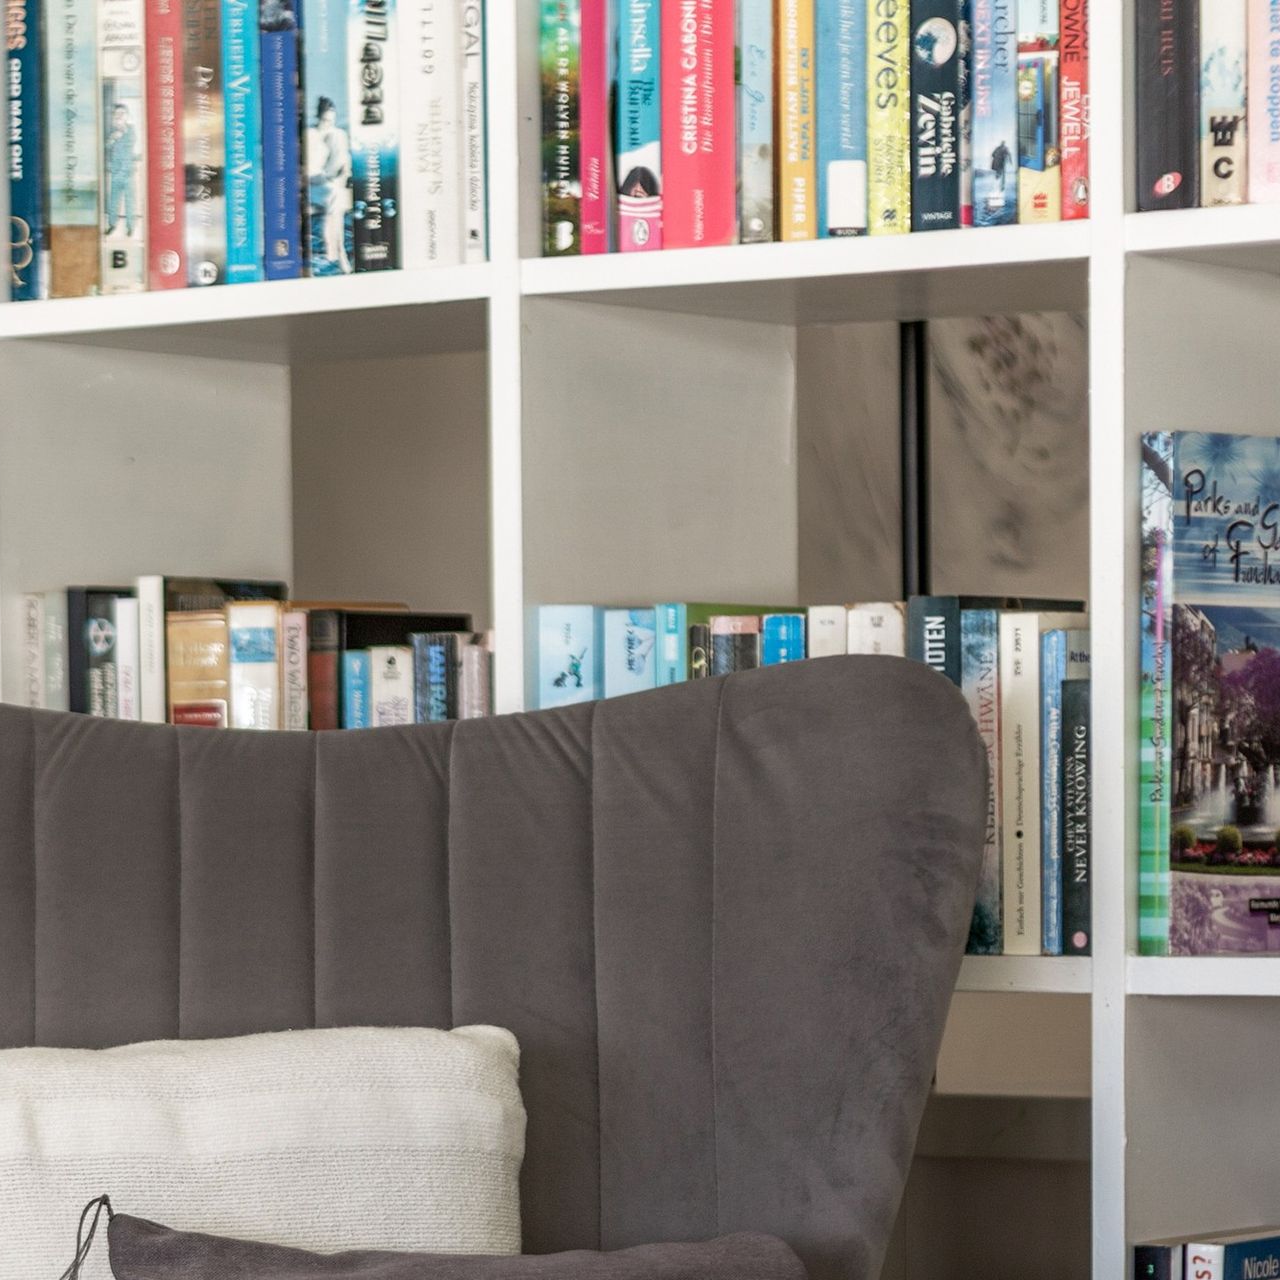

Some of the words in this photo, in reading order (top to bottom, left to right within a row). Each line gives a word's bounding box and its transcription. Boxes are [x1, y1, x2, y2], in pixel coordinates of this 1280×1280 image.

[557, 27, 570, 52] ALS
[680, 0, 699, 70] CABONI
[976, 0, 992, 45] NEXT
[994, 0, 1016, 73] rcher
[9, 58, 23, 97] ODD
[557, 57, 570, 76] DE
[799, 46, 811, 69] AN
[976, 48, 992, 69] IN
[557, 80, 571, 139] WOLVEN
[627, 79, 645, 147] Burnout
[642, 77, 655, 105] The
[742, 84, 766, 131] Green
[976, 75, 992, 118] LINE
[9, 100, 23, 141] MAN
[680, 74, 699, 154] CRISTINA
[785, 90, 799, 162] BASTIAN
[839, 113, 856, 150] vertel
[916, 92, 943, 177] Zevin
[940, 92, 957, 176] Gabrielle
[1062, 75, 1081, 161] JEWELL
[10, 144, 24, 180] OUT
[416, 122, 431, 174] KARIN
[426, 97, 443, 196] SLAUGHTER
[799, 121, 811, 160] PAPA
[558, 145, 572, 198] HUILEN
[1213, 156, 1234, 180] C
[793, 177, 807, 223] PIPER
[112, 250, 127, 269] B
[1181, 468, 1231, 525] Parks
[1233, 493, 1260, 516] and
[1200, 532, 1220, 568] of
[287, 625, 304, 665] two
[427, 644, 447, 683] IAN
[1049, 707, 1061, 719] At
[1050, 721, 1062, 739] the
[1049, 741, 1062, 803] Cattleman's
[1065, 755, 1076, 810] STEVENS
[1074, 725, 1088, 817] KNOWING
[1050, 805, 1062, 859] Command
[1065, 812, 1076, 853] CHEVY
[1074, 823, 1088, 883] NEVER
[1014, 842, 1026, 890] Geschichten
[1014, 906, 1026, 936] Einfach
[1243, 1256, 1279, 1280] Nicole
